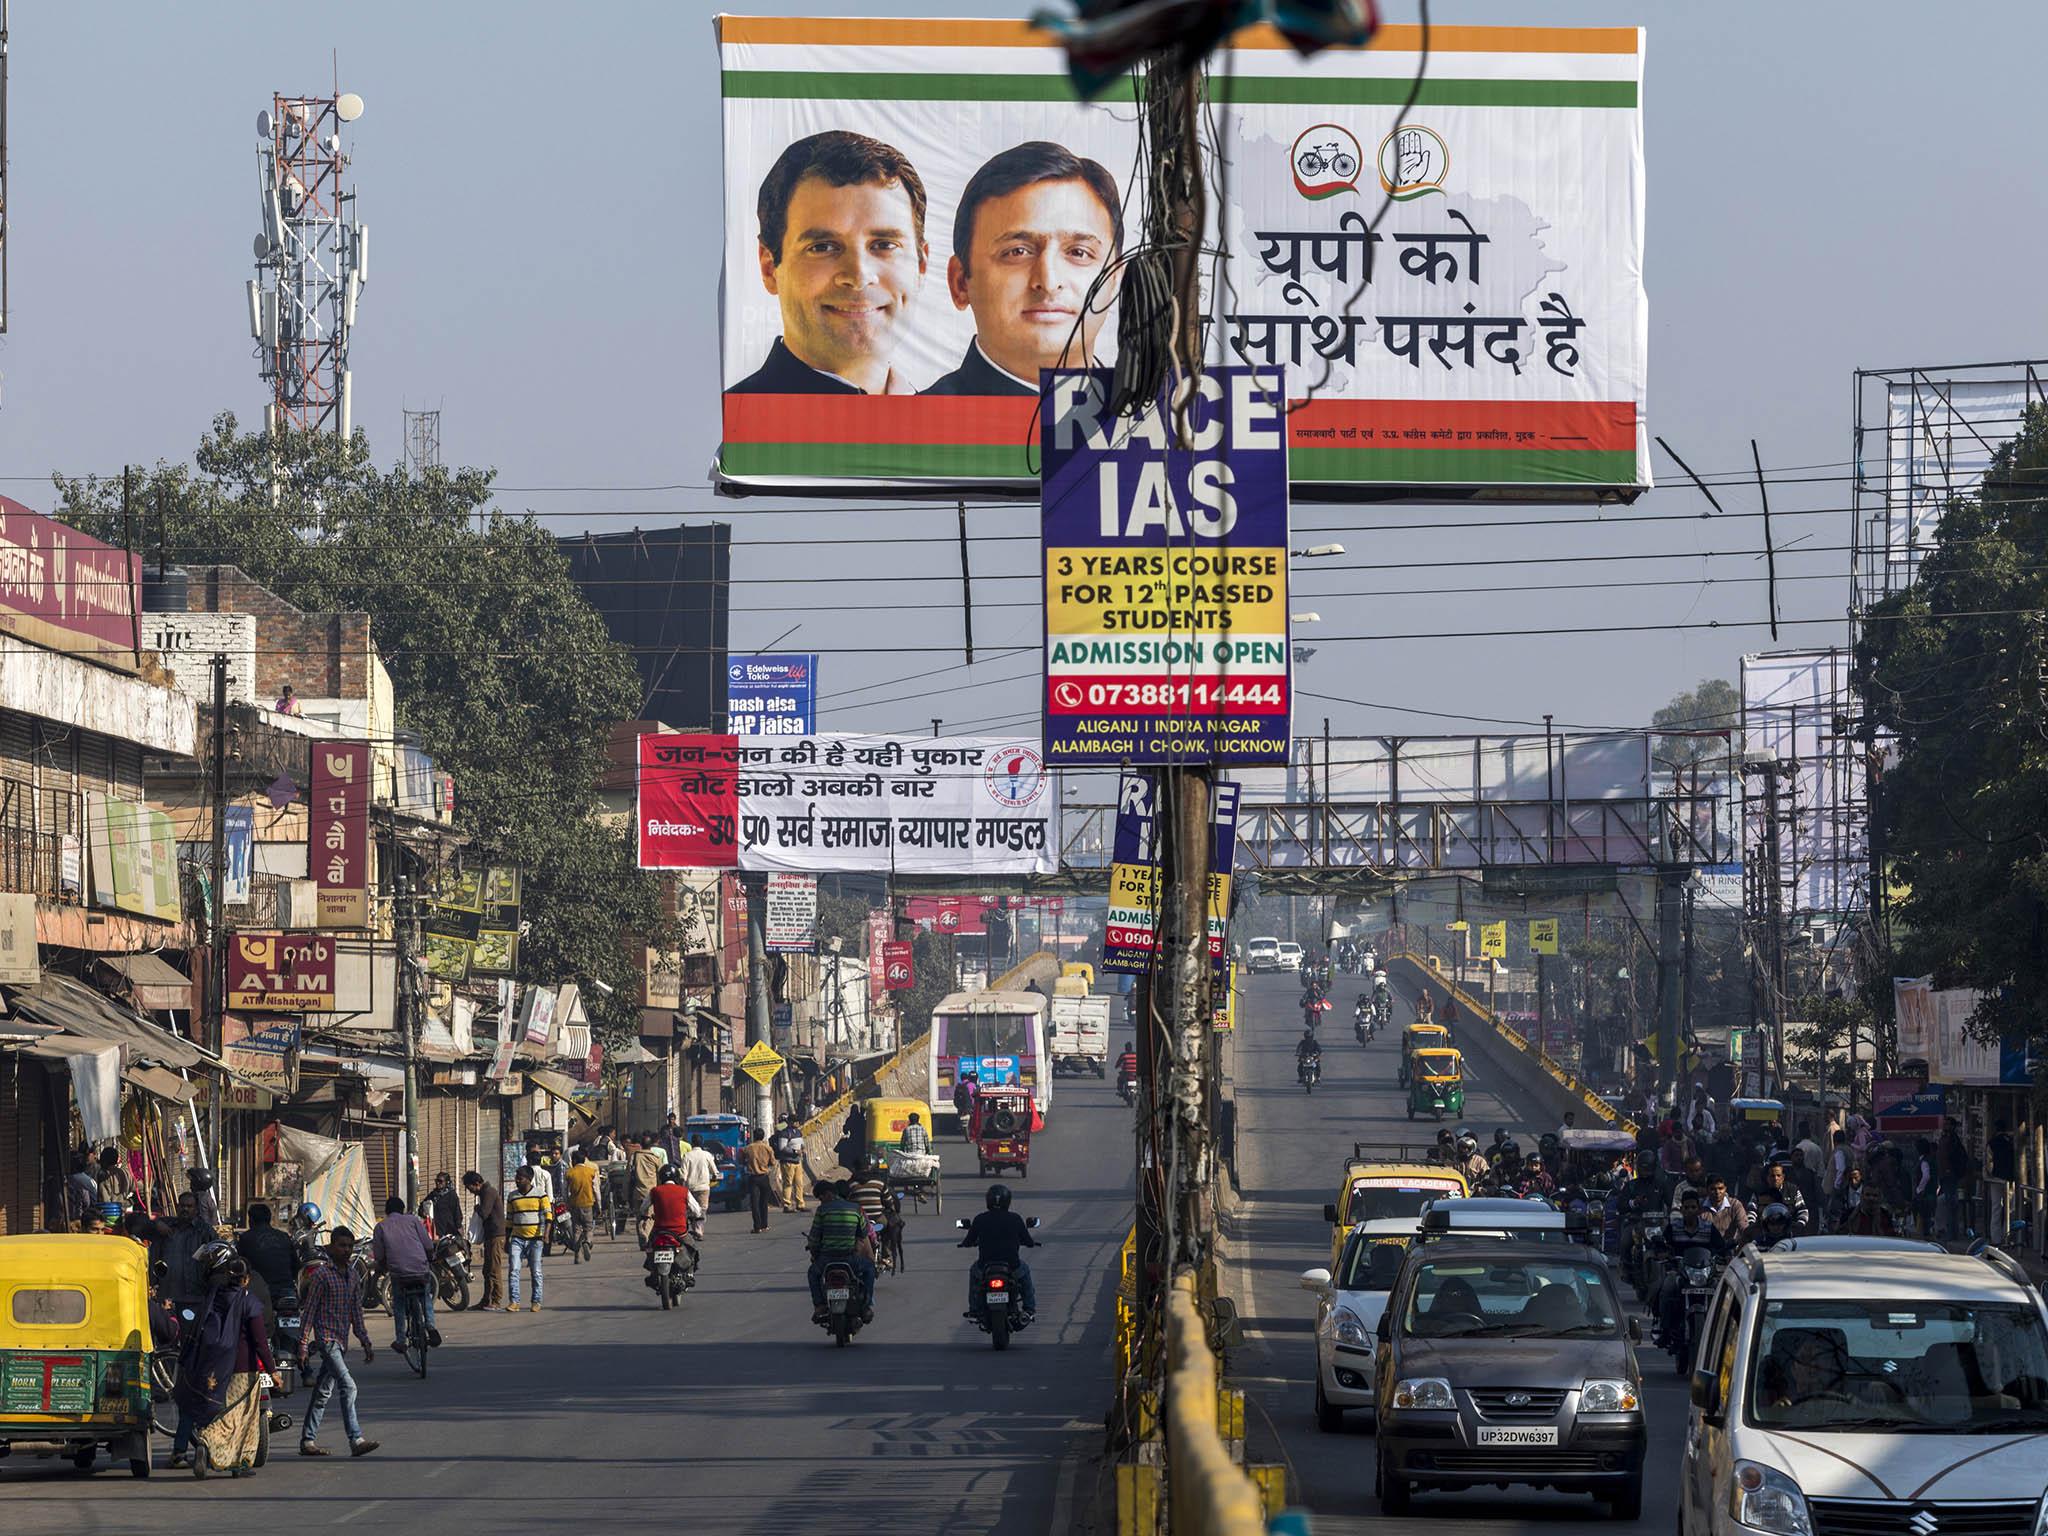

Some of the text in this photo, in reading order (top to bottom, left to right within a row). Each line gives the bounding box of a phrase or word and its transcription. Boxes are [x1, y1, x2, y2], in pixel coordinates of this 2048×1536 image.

[1254, 209, 1489, 307] यूपी को
[1224, 314, 1366, 367] साथ
[1376, 302, 1528, 375] पसंद
[1538, 293, 1586, 377] है
[1054, 374, 1280, 450] RACE
[1100, 460, 1238, 538] IAS
[1057, 556, 1277, 576] 3 YEARS COURSE
[1061, 585, 1113, 604] FOR
[1176, 584, 1273, 604] PASSED
[1103, 609, 1232, 629] STUDENTS
[1051, 641, 1284, 664] ADMISSION OPEN
[746, 664, 789, 673] Edelweiss
[747, 673, 770, 681] Tokio
[1089, 683, 1280, 705] 07388114444
[1076, 720, 1139, 733] ALIGANJ
[1155, 721, 1201, 733] INDIRA
[1207, 720, 1260, 733] NAGAR
[1051, 740, 1133, 753] ALAMBAGH
[1215, 740, 1286, 753] LUCKNOW
[655, 745, 774, 764] जन-जन
[780, 740, 818, 765] की
[825, 741, 847, 767] है
[854, 742, 905, 767] यही
[911, 749, 986, 775] पुकार
[680, 772, 937, 798] वोट डालो अबकी बार
[776, 803, 815, 848] सर्व
[821, 817, 893, 849] समाज
[898, 817, 972, 849] व्यापार
[976, 817, 1048, 851] मण्डल
[1119, 881, 1145, 893] FOR
[941, 913, 957, 925] 4G
[1485, 939, 1502, 947] 4G
[1534, 933, 1554, 942] 4G
[889, 965, 908, 980] 4G
[238, 973, 328, 991] ATM
[241, 996, 263, 1005] ATM
[1407, 1179, 1453, 1188] ACADEMY
[11, 1377, 83, 1388] HORN PLEASE
[1481, 1431, 1554, 1443] UP32DW6397
